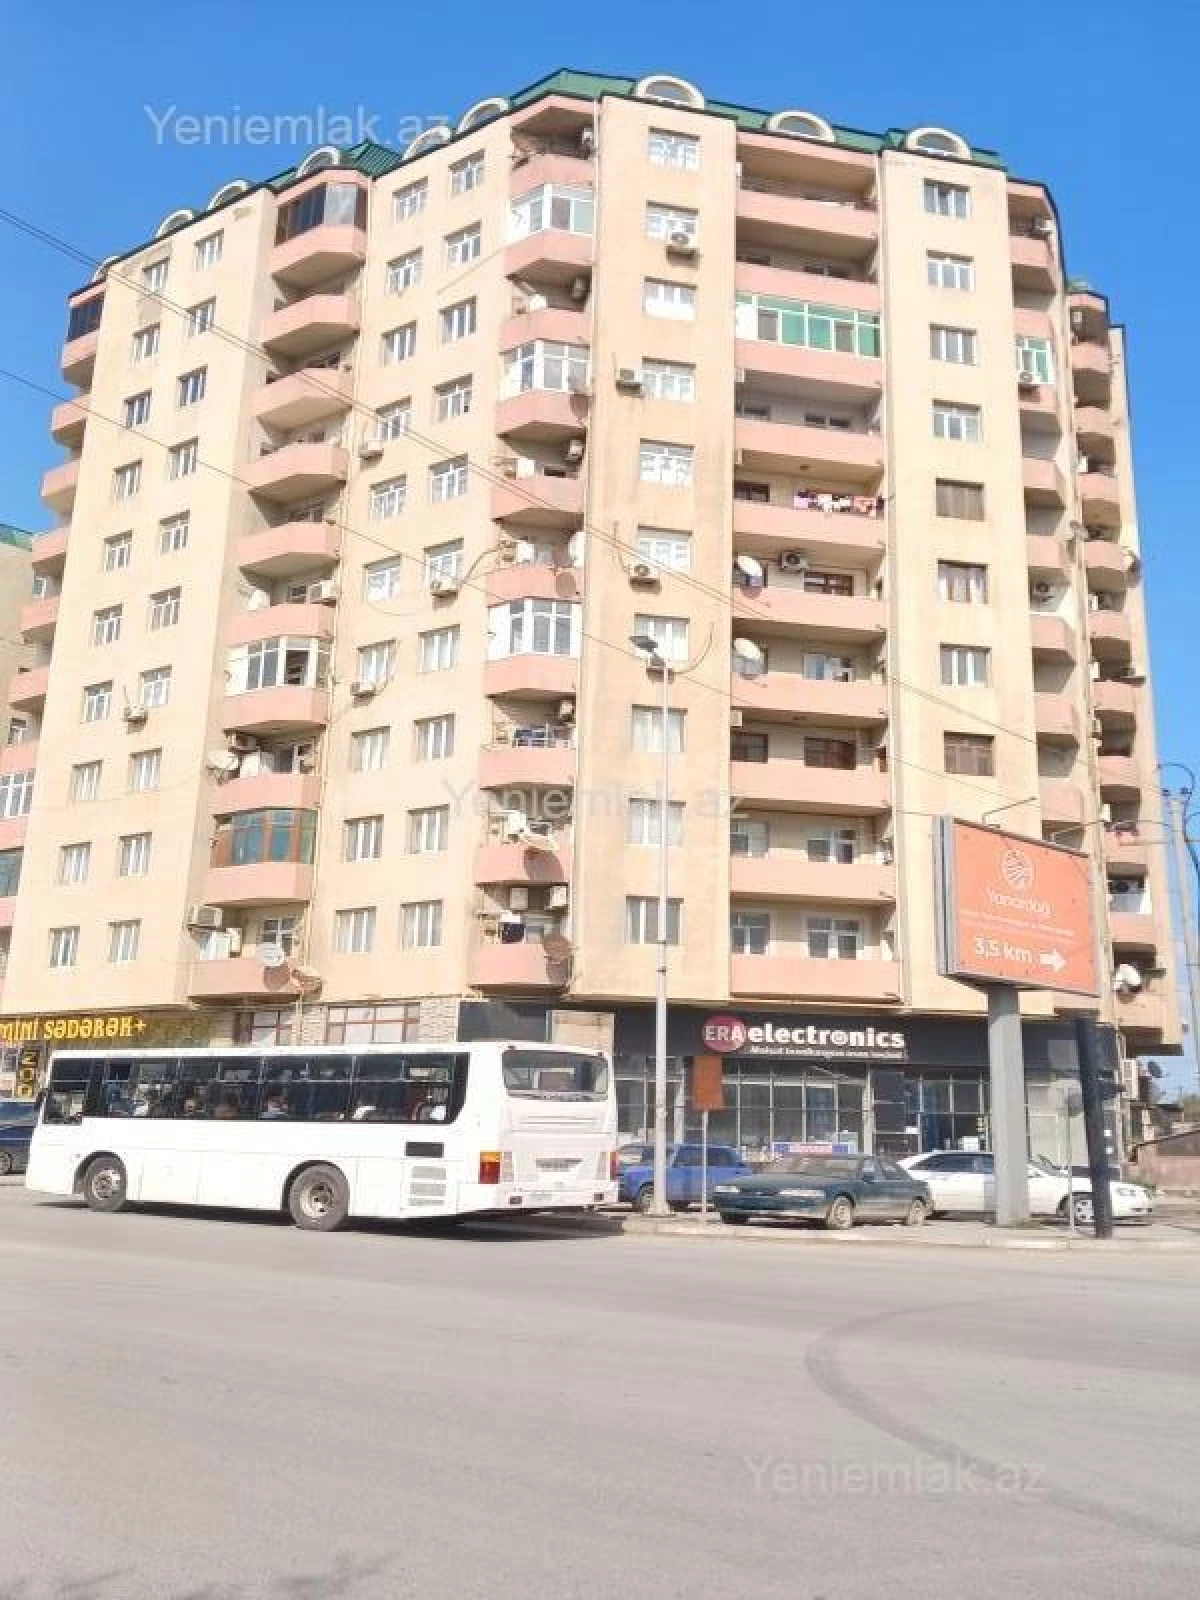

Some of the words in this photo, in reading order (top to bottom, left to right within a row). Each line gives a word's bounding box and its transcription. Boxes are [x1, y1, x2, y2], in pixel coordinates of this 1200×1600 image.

[975, 936, 1000, 959] 3,5
[1003, 941, 1033, 963] km
[748, 1023, 905, 1049] electronics
